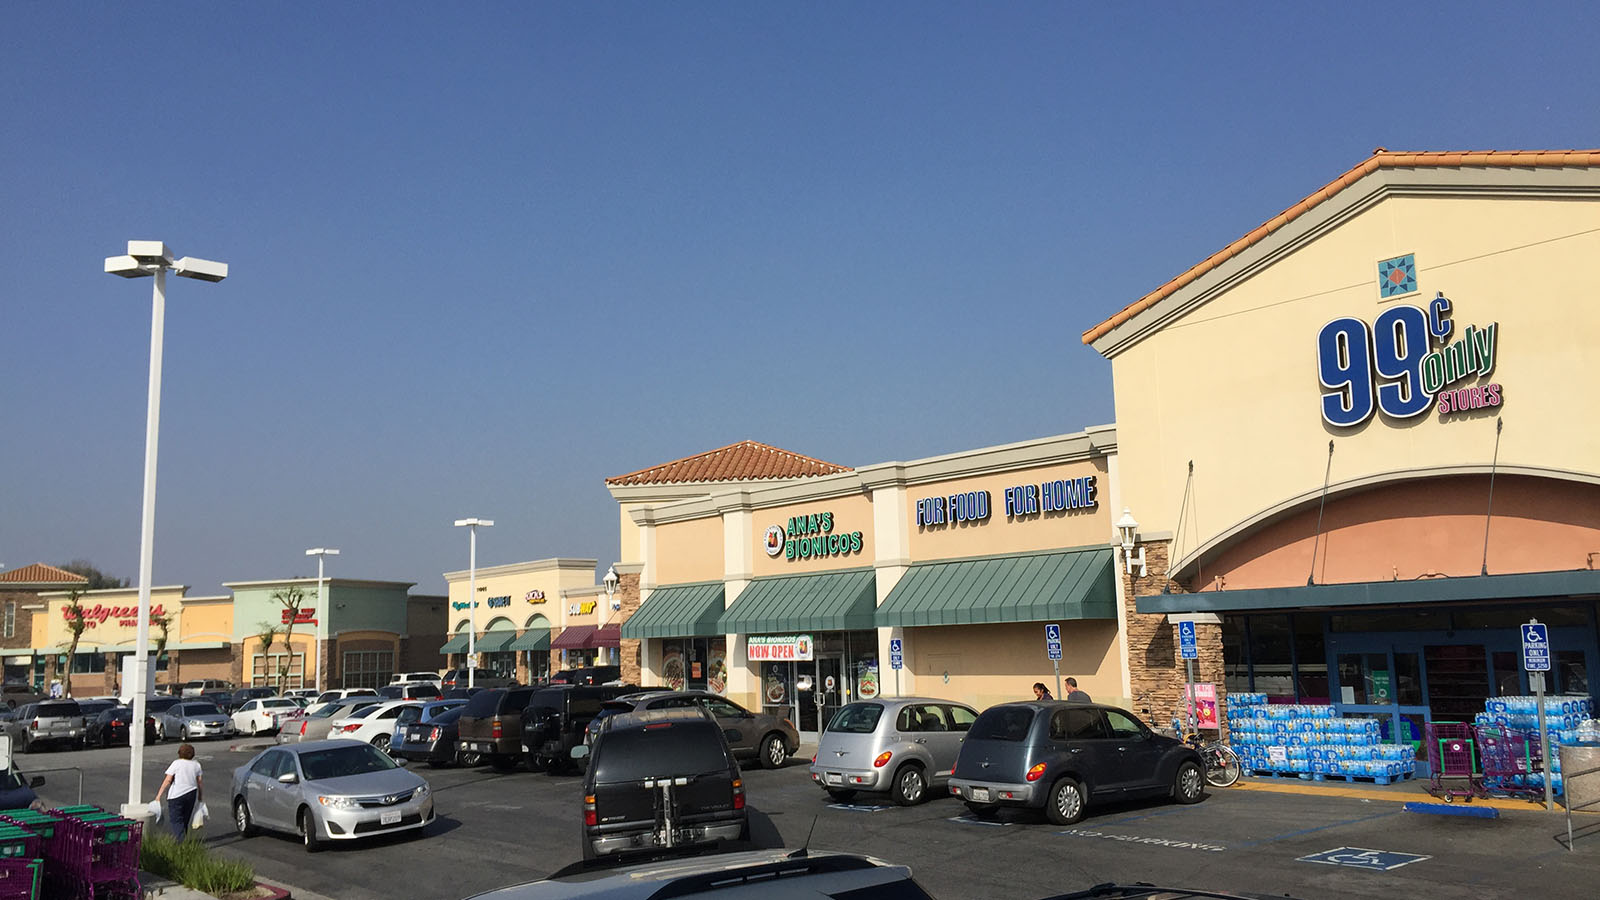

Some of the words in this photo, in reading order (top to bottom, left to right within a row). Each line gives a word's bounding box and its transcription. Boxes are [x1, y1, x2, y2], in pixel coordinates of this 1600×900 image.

[1423, 321, 1497, 394] only
[1438, 383, 1501, 414] STORES
[916, 496, 944, 526] FOR
[948, 490, 988, 523] FOOD
[1004, 484, 1037, 517] FOR
[1042, 476, 1095, 512] HOME
[786, 512, 832, 536] ANA'S
[785, 531, 861, 559] BIONICOS
[61, 604, 166, 624] Walgrees
[568, 601, 597, 616] SUBWAY
[749, 645, 769, 658] NOW
[771, 645, 794, 658] OPEN
[1103, 833, 1228, 852] PARKING
